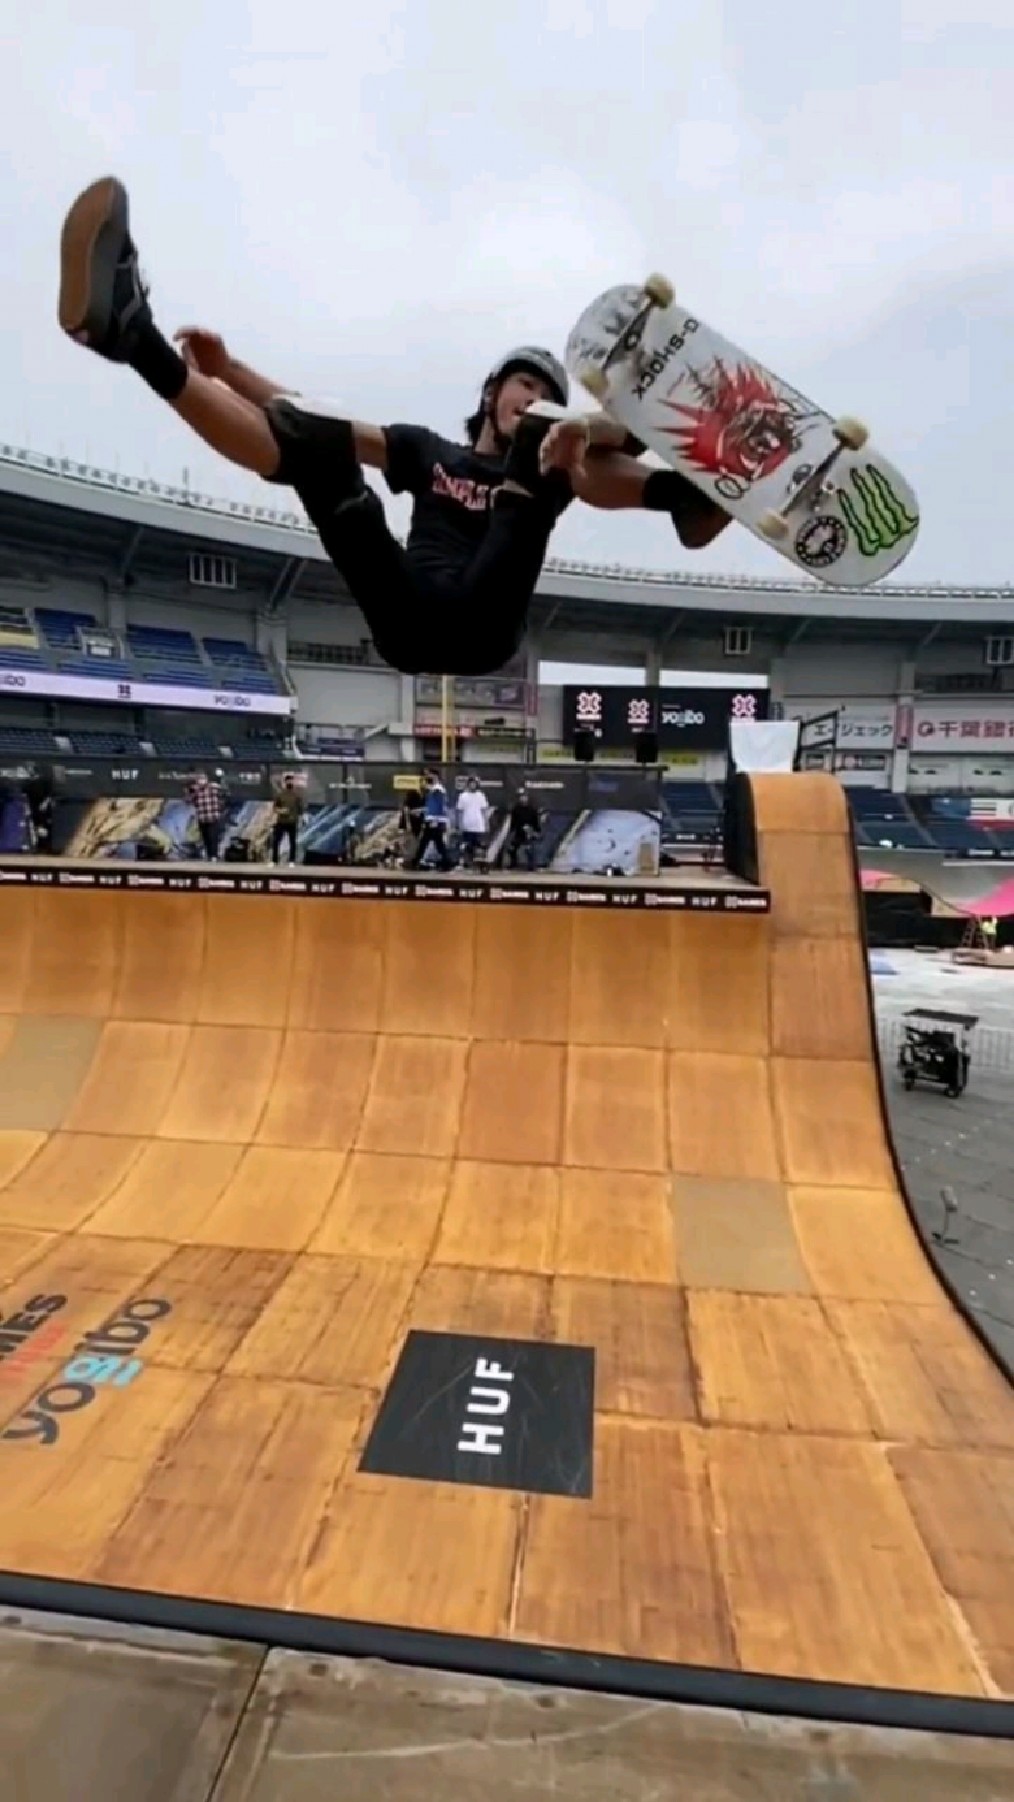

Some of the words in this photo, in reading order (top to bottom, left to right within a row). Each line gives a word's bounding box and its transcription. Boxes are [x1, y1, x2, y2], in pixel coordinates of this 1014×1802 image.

[632, 318, 699, 400] G-SHOCK
[2, 1299, 172, 1445] yogibo
[457, 1357, 514, 1455] HUF
